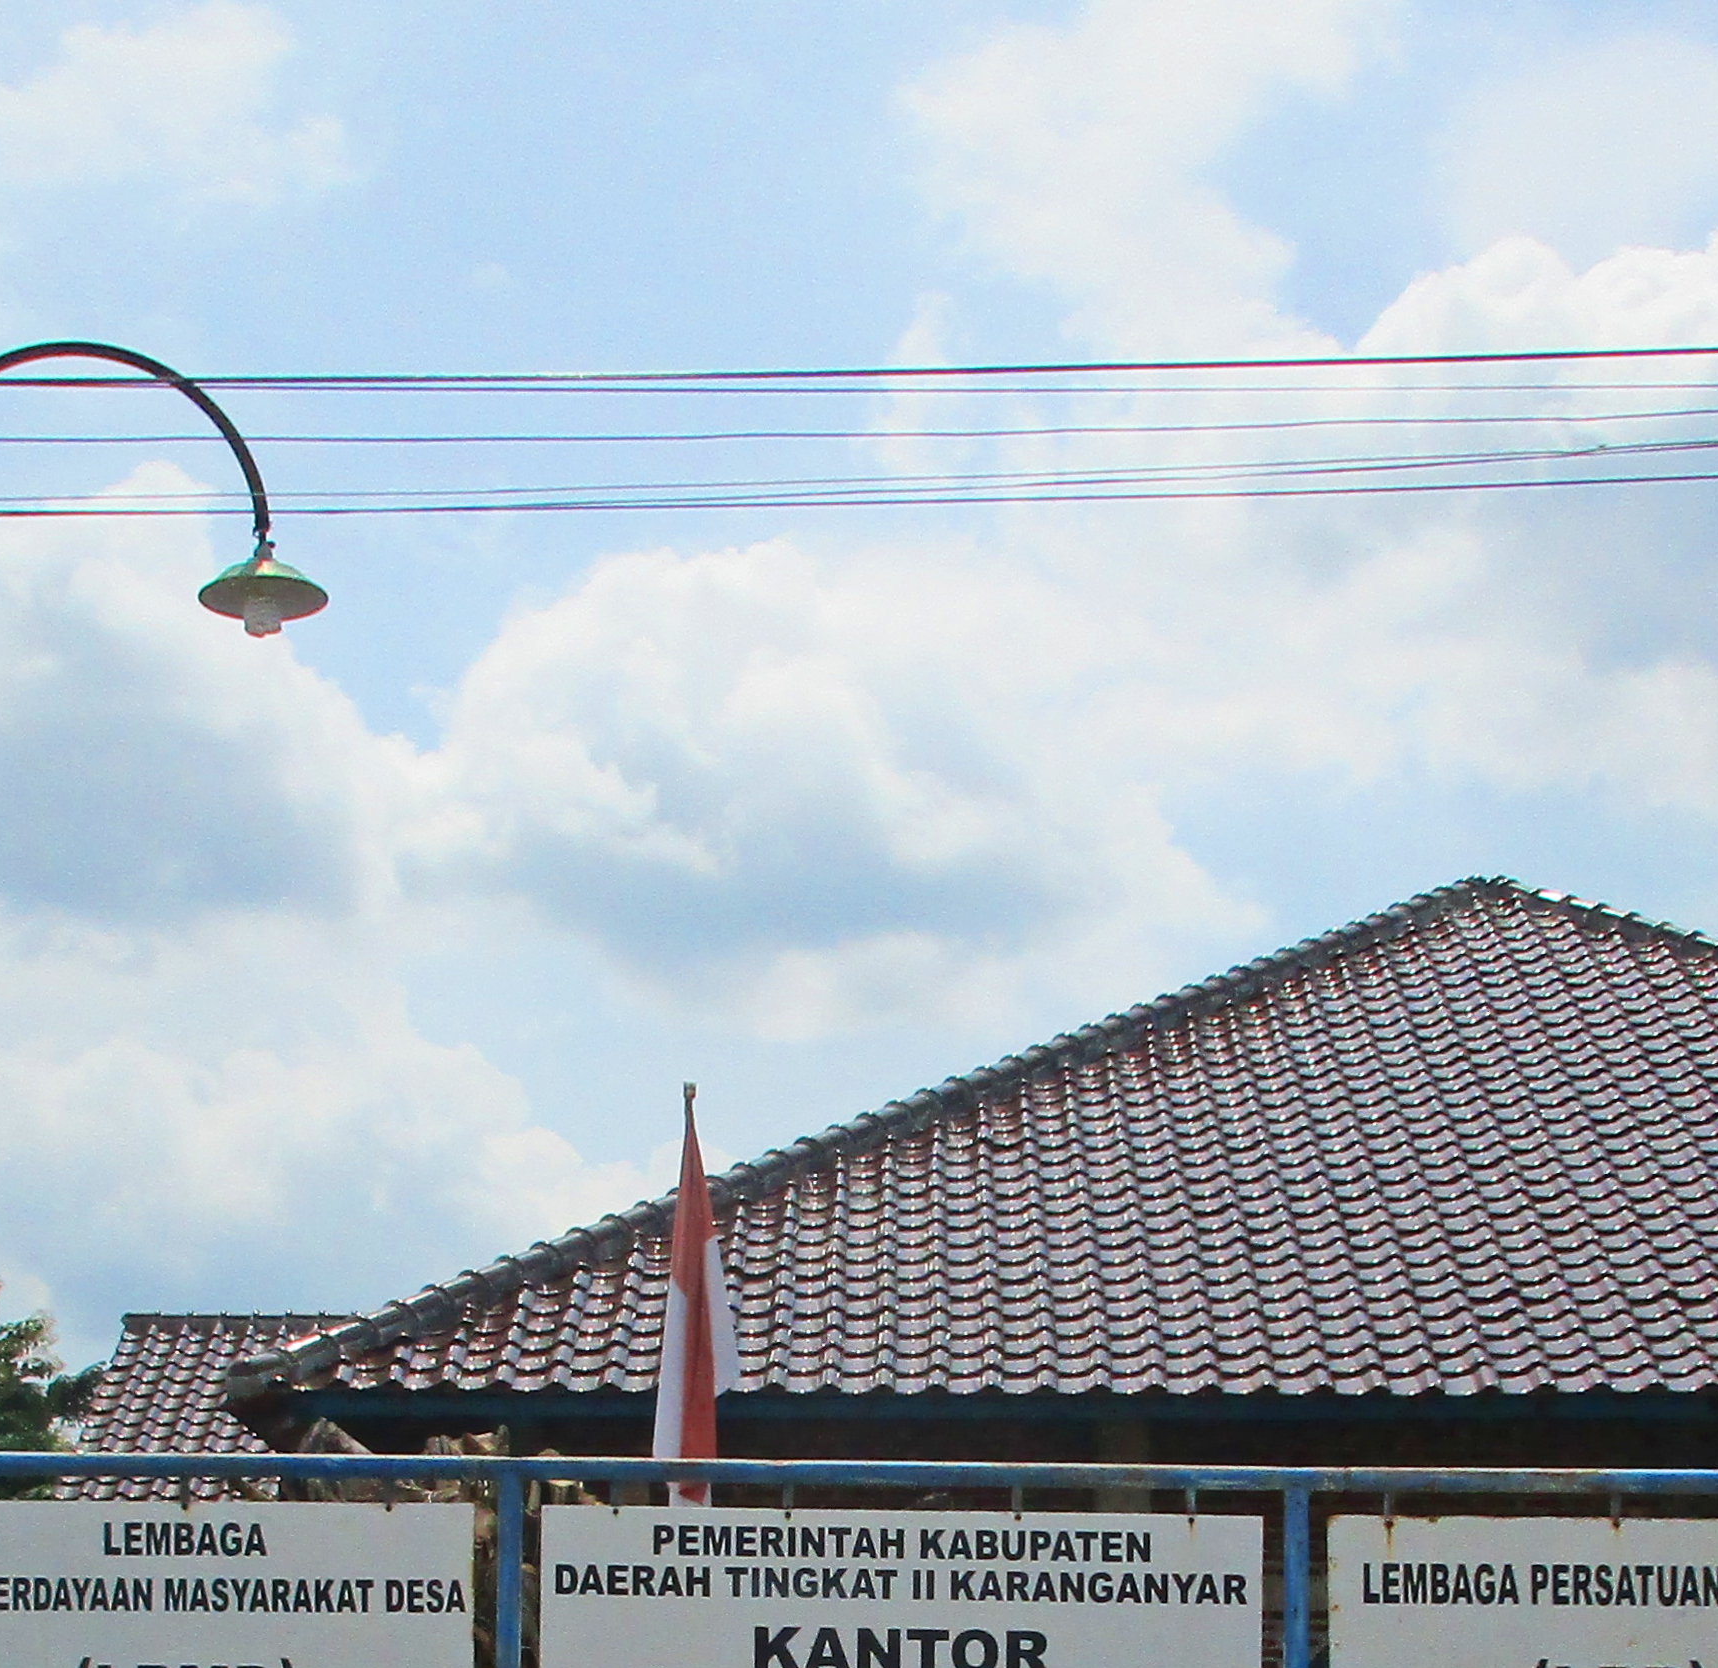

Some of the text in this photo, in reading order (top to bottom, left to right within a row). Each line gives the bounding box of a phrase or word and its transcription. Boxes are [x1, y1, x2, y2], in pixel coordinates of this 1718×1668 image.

[103, 1521, 268, 1557] LEMBAGA
[652, 1524, 1152, 1563] PEMERINTAH KABUPATEN
[164, 1577, 375, 1613] MASYARAKAT
[384, 1578, 466, 1614] DESA
[554, 1563, 1248, 1606] DAERAH TINGKAT II KARANGANYAR
[1362, 1562, 1520, 1606] LEMBAGA
